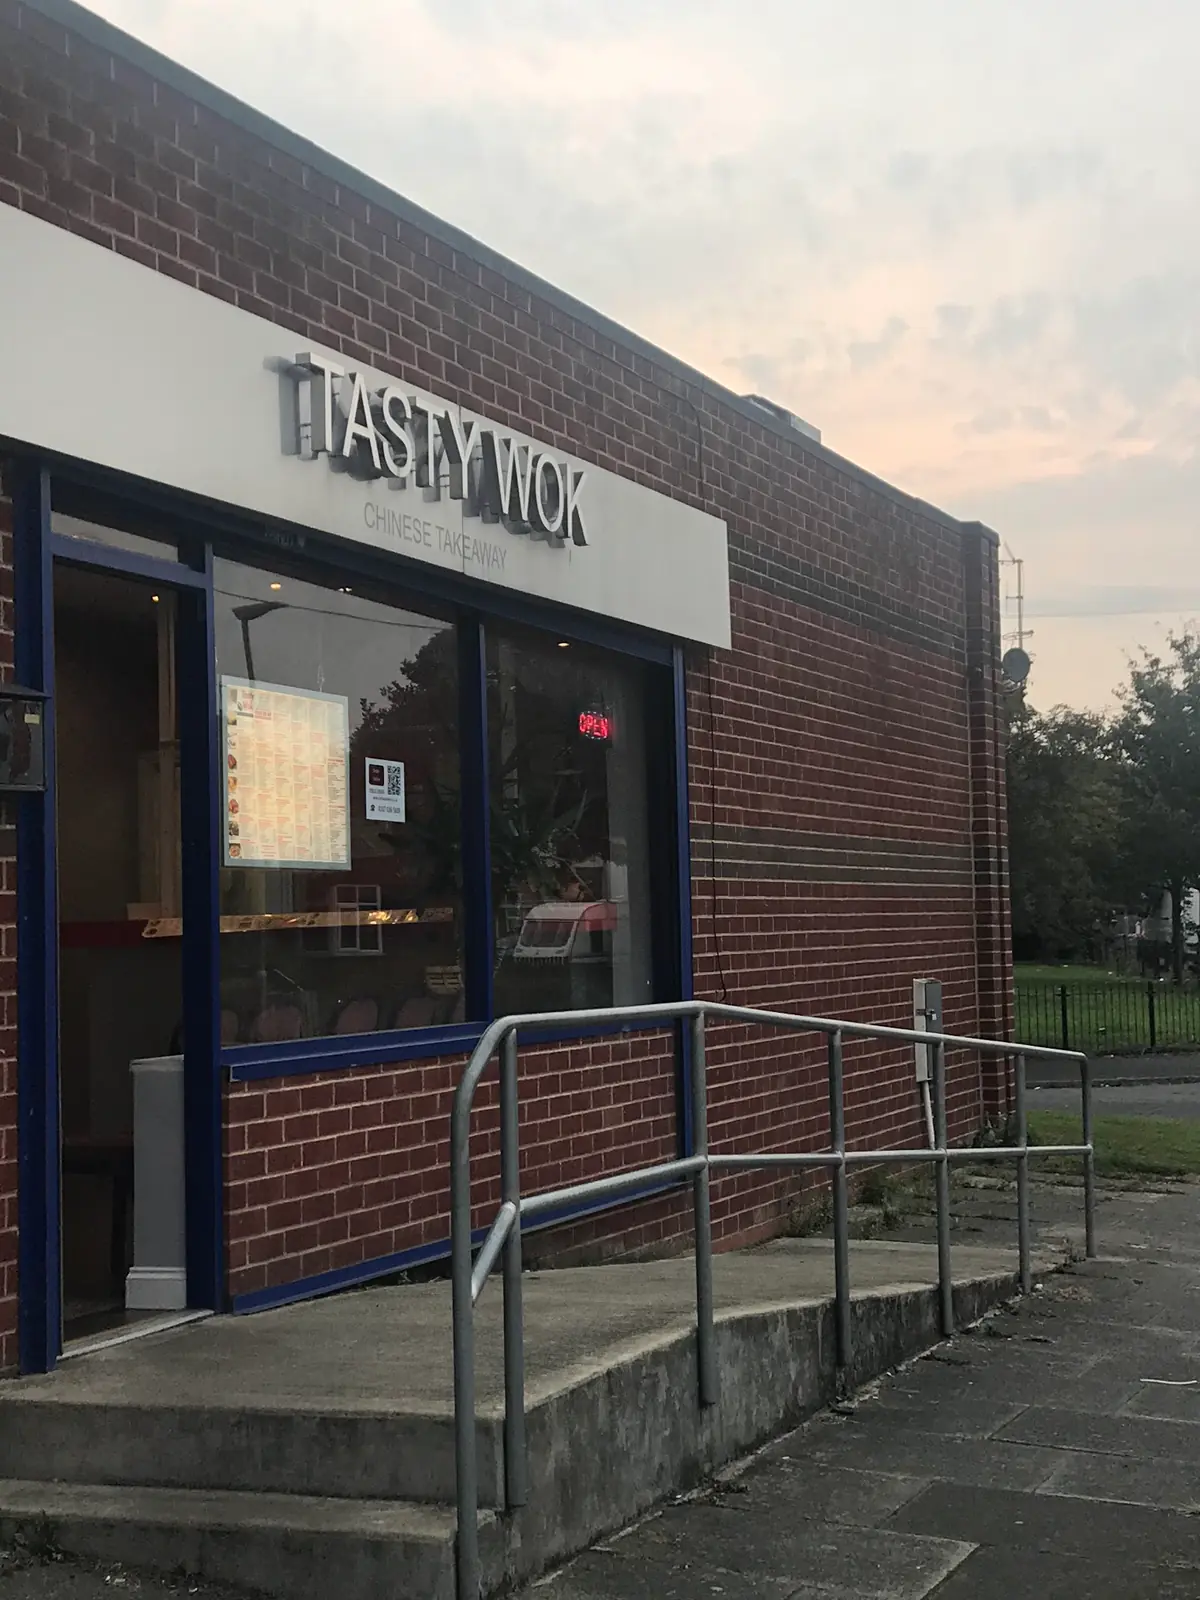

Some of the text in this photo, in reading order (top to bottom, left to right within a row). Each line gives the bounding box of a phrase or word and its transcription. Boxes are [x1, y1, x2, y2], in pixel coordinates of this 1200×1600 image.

[299, 352, 590, 547] TASTY WOK
[363, 502, 508, 570] CHINESE TAKEAWAY
[579, 713, 608, 738] OPEN
